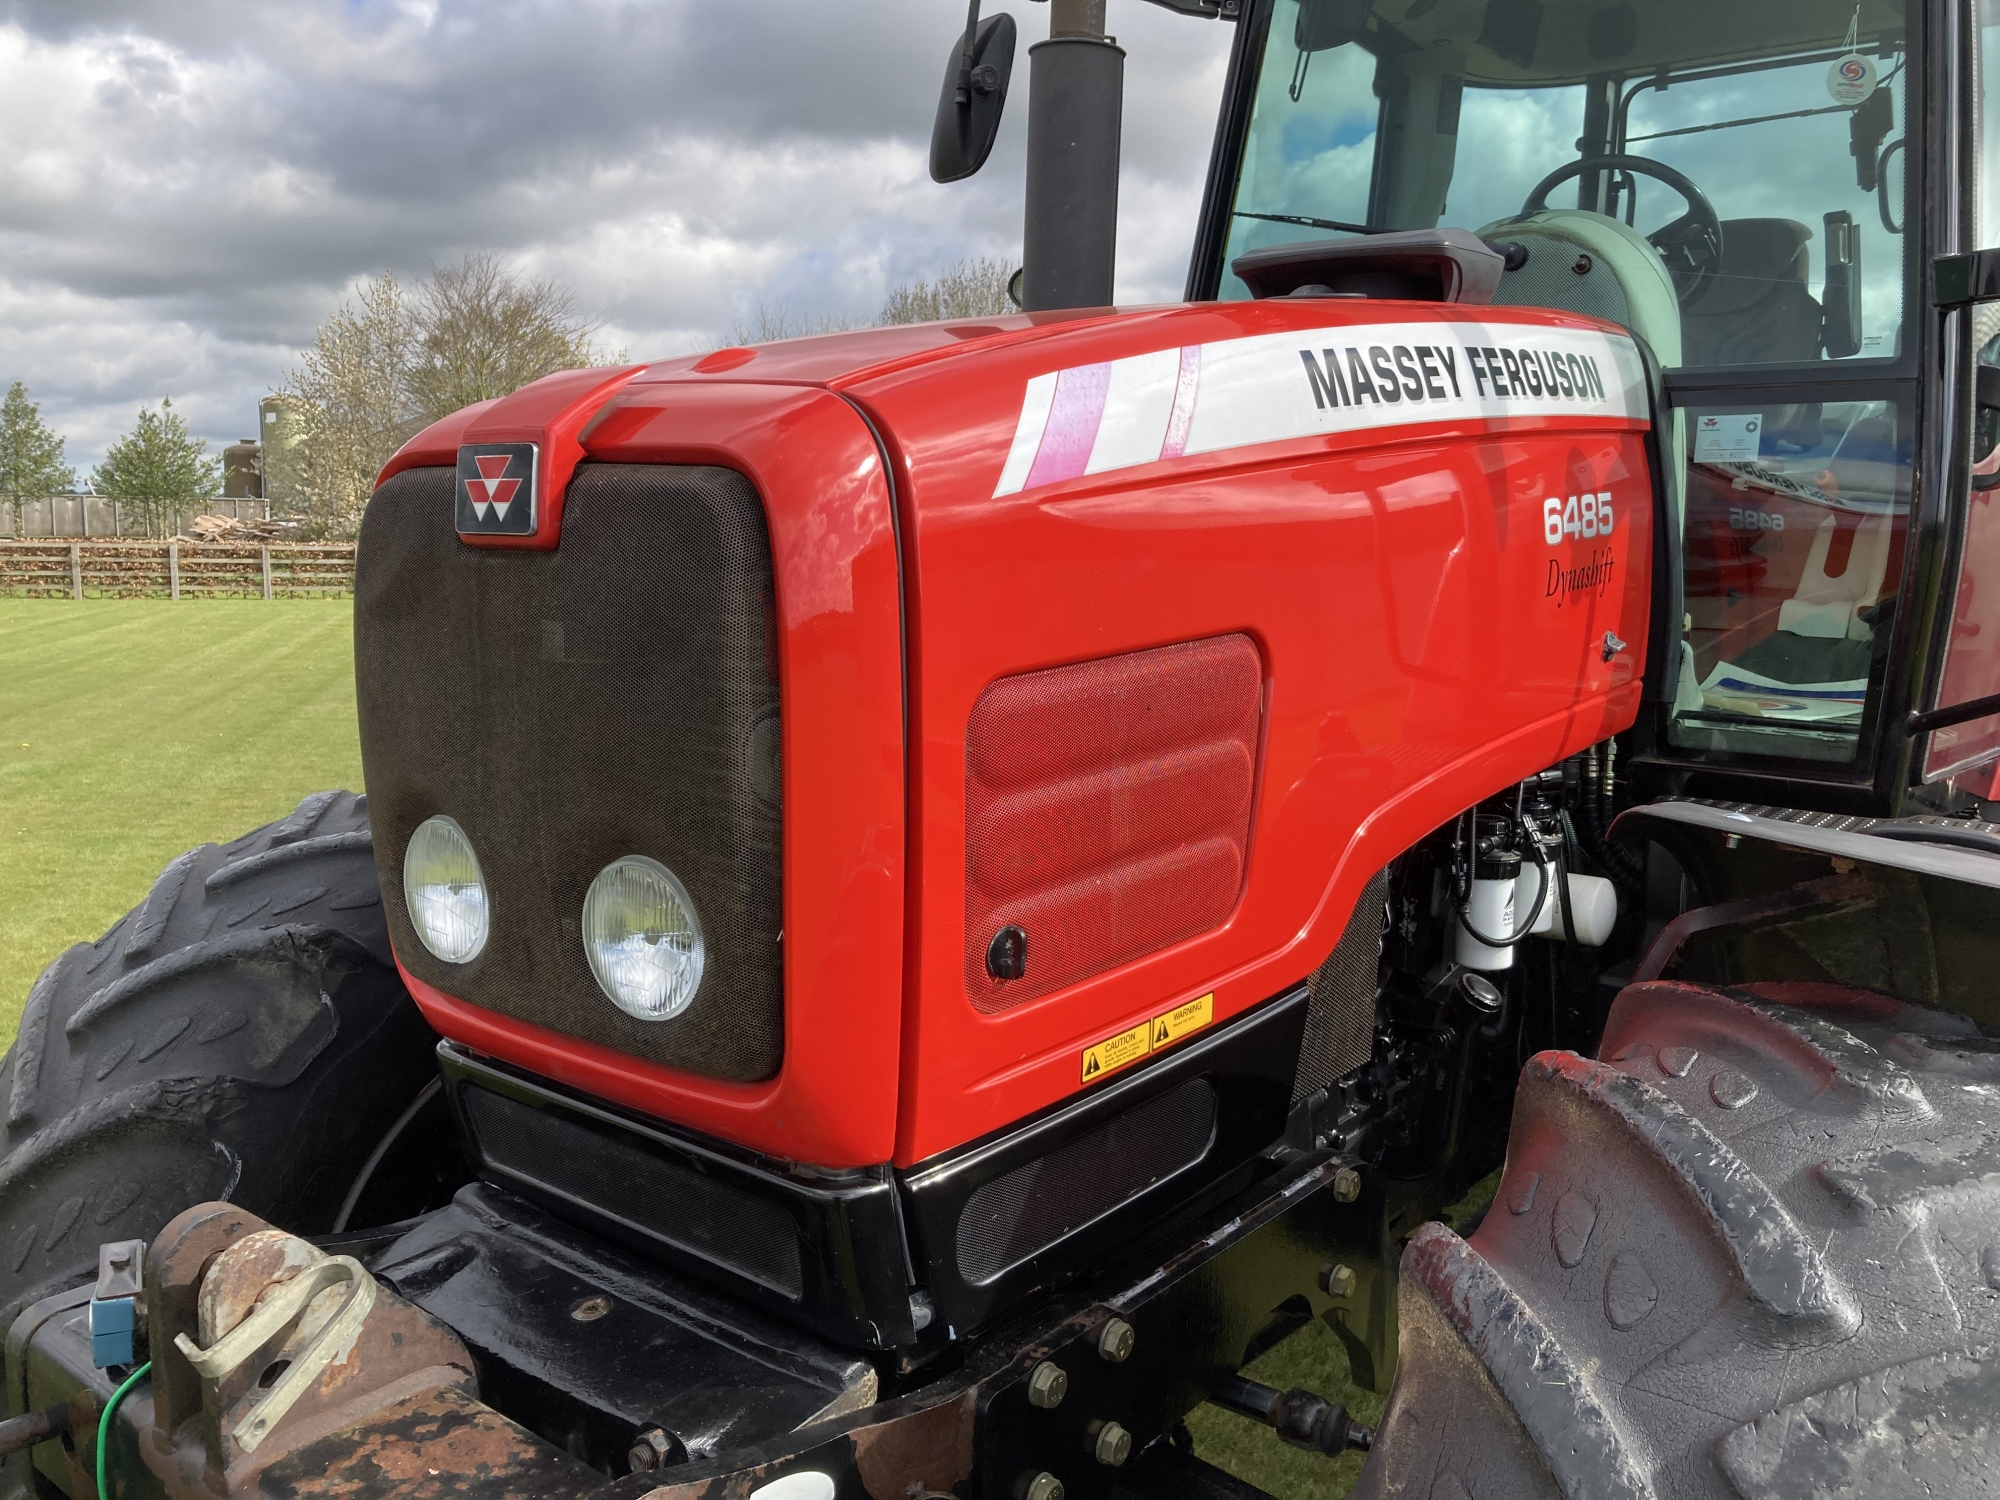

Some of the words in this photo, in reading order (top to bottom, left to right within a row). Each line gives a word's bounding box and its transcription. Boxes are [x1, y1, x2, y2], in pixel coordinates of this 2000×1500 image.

[1299, 345, 1462, 410] MASSEY
[1464, 347, 1605, 400] FERGUSON
[1543, 492, 1613, 546] 6485
[1545, 547, 1614, 608] Dynashift
[1173, 1001, 1202, 1021] WARNING
[1104, 1031, 1136, 1053] CAUTION
